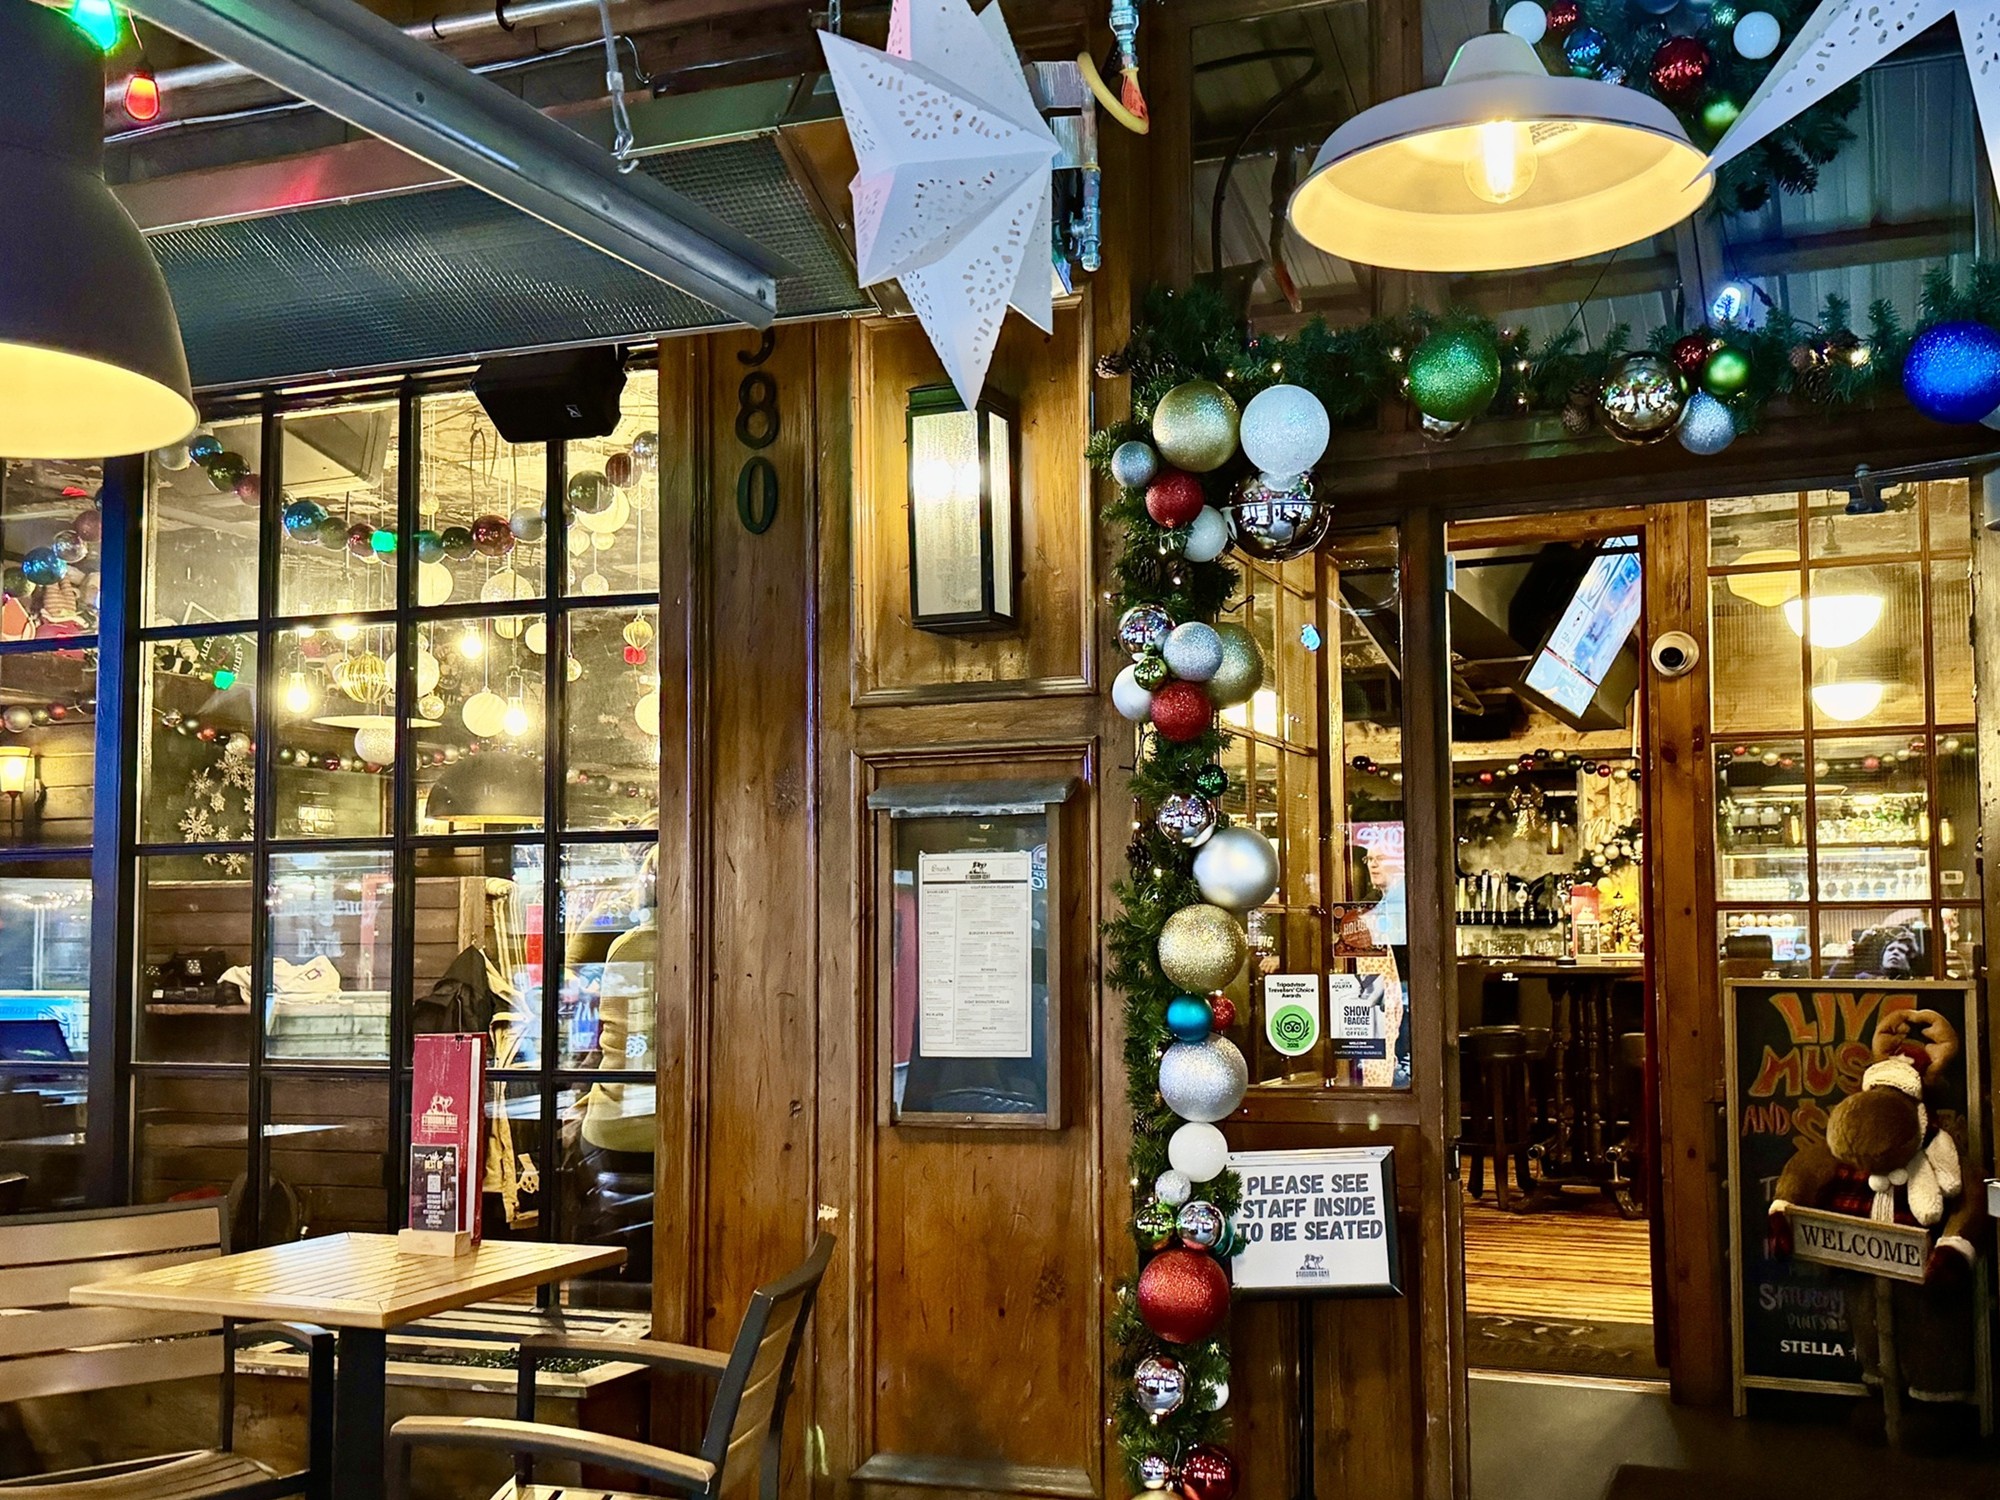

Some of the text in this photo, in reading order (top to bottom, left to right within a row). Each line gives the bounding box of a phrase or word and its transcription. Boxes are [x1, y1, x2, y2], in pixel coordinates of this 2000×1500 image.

[1343, 1005, 1370, 1017] SHOW
[1347, 1016, 1370, 1026] BADGE
[1742, 1102, 1791, 1137] AND
[1247, 1173, 1369, 1195] PLEASE SEE
[1243, 1196, 1376, 1219] STAFF INSIDE
[1236, 1220, 1383, 1242] TO BE SEATED
[1801, 1224, 1921, 1267] WELCOME
[1780, 1339, 1845, 1357] STELLA
